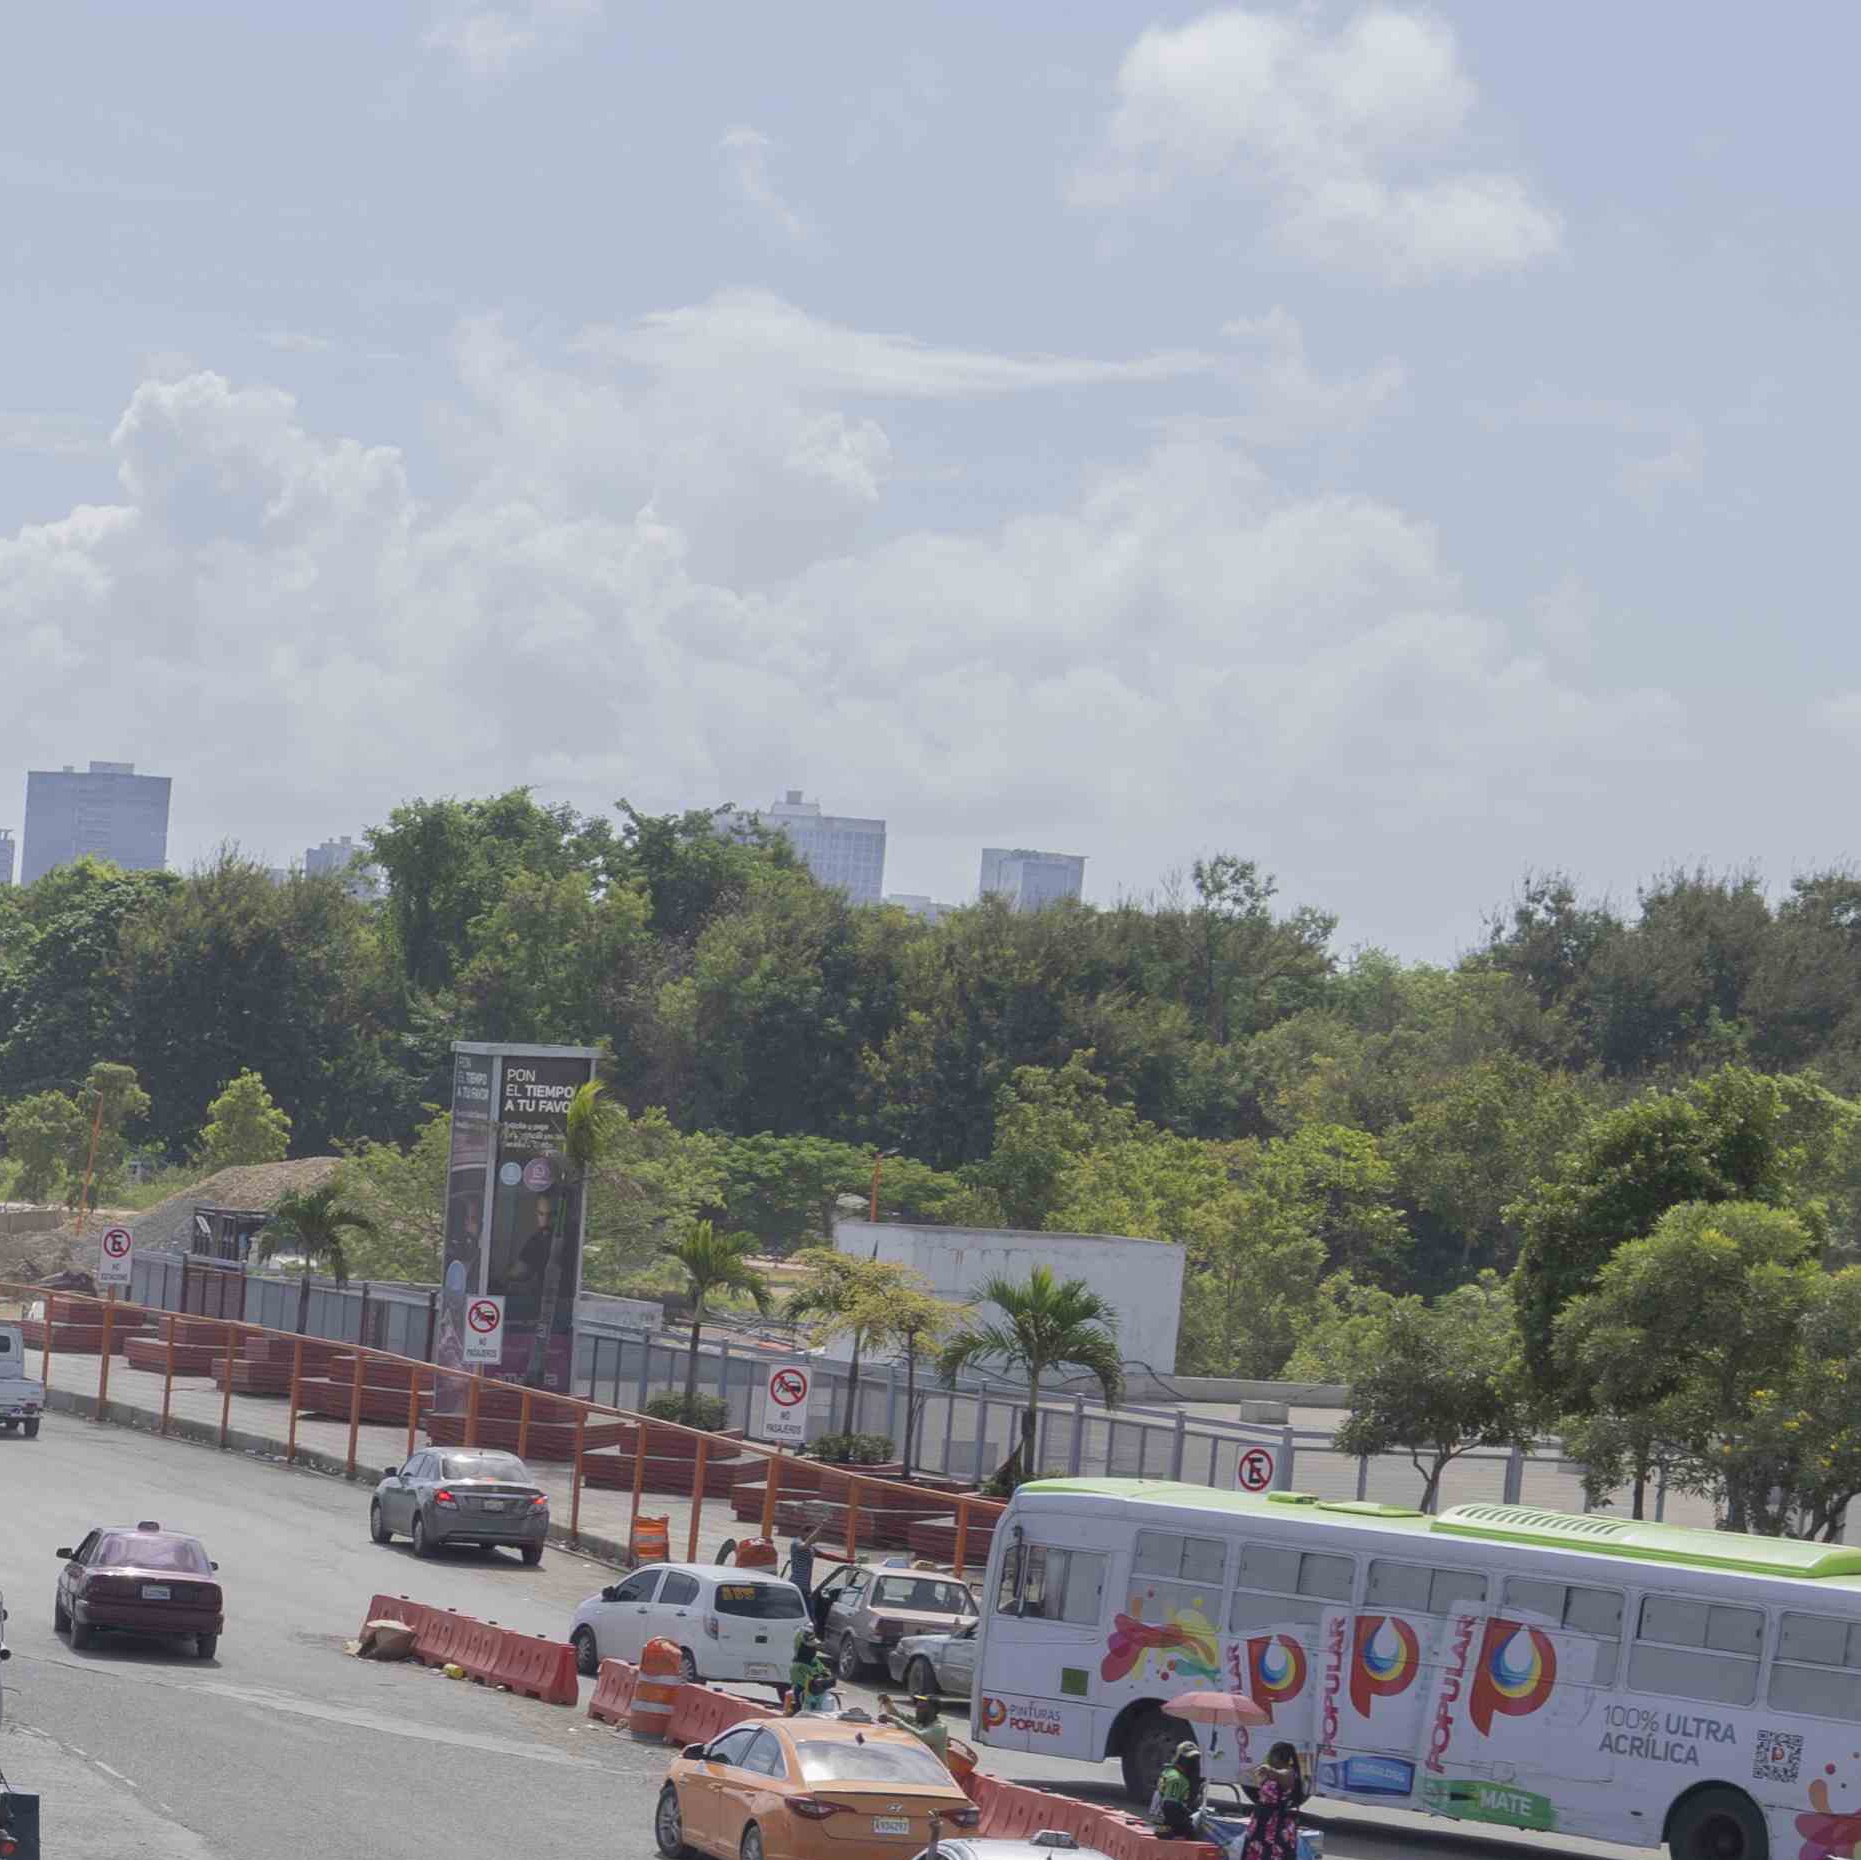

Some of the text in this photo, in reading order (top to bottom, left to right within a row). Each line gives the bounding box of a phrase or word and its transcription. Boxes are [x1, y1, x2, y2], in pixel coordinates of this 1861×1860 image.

[507, 1068, 536, 1082] PON
[505, 1083, 575, 1099] EL TIEMPO
[504, 1099, 571, 1114] A TU FAVO
[780, 1410, 791, 1421] NO
[766, 1423, 802, 1435] PASAJEROS
[1248, 1456, 1264, 1484] E
[1319, 1616, 1346, 1758] POPULAR
[1425, 1614, 1478, 1774] POPULAR
[1009, 1703, 1061, 1722] PINTURAS
[1009, 1717, 1061, 1736] POPULAR
[1604, 1704, 1737, 1745] 100% ULTRA
[1598, 1731, 1700, 1767] ACRÍLICA
[1481, 1789, 1532, 1817] MATE
